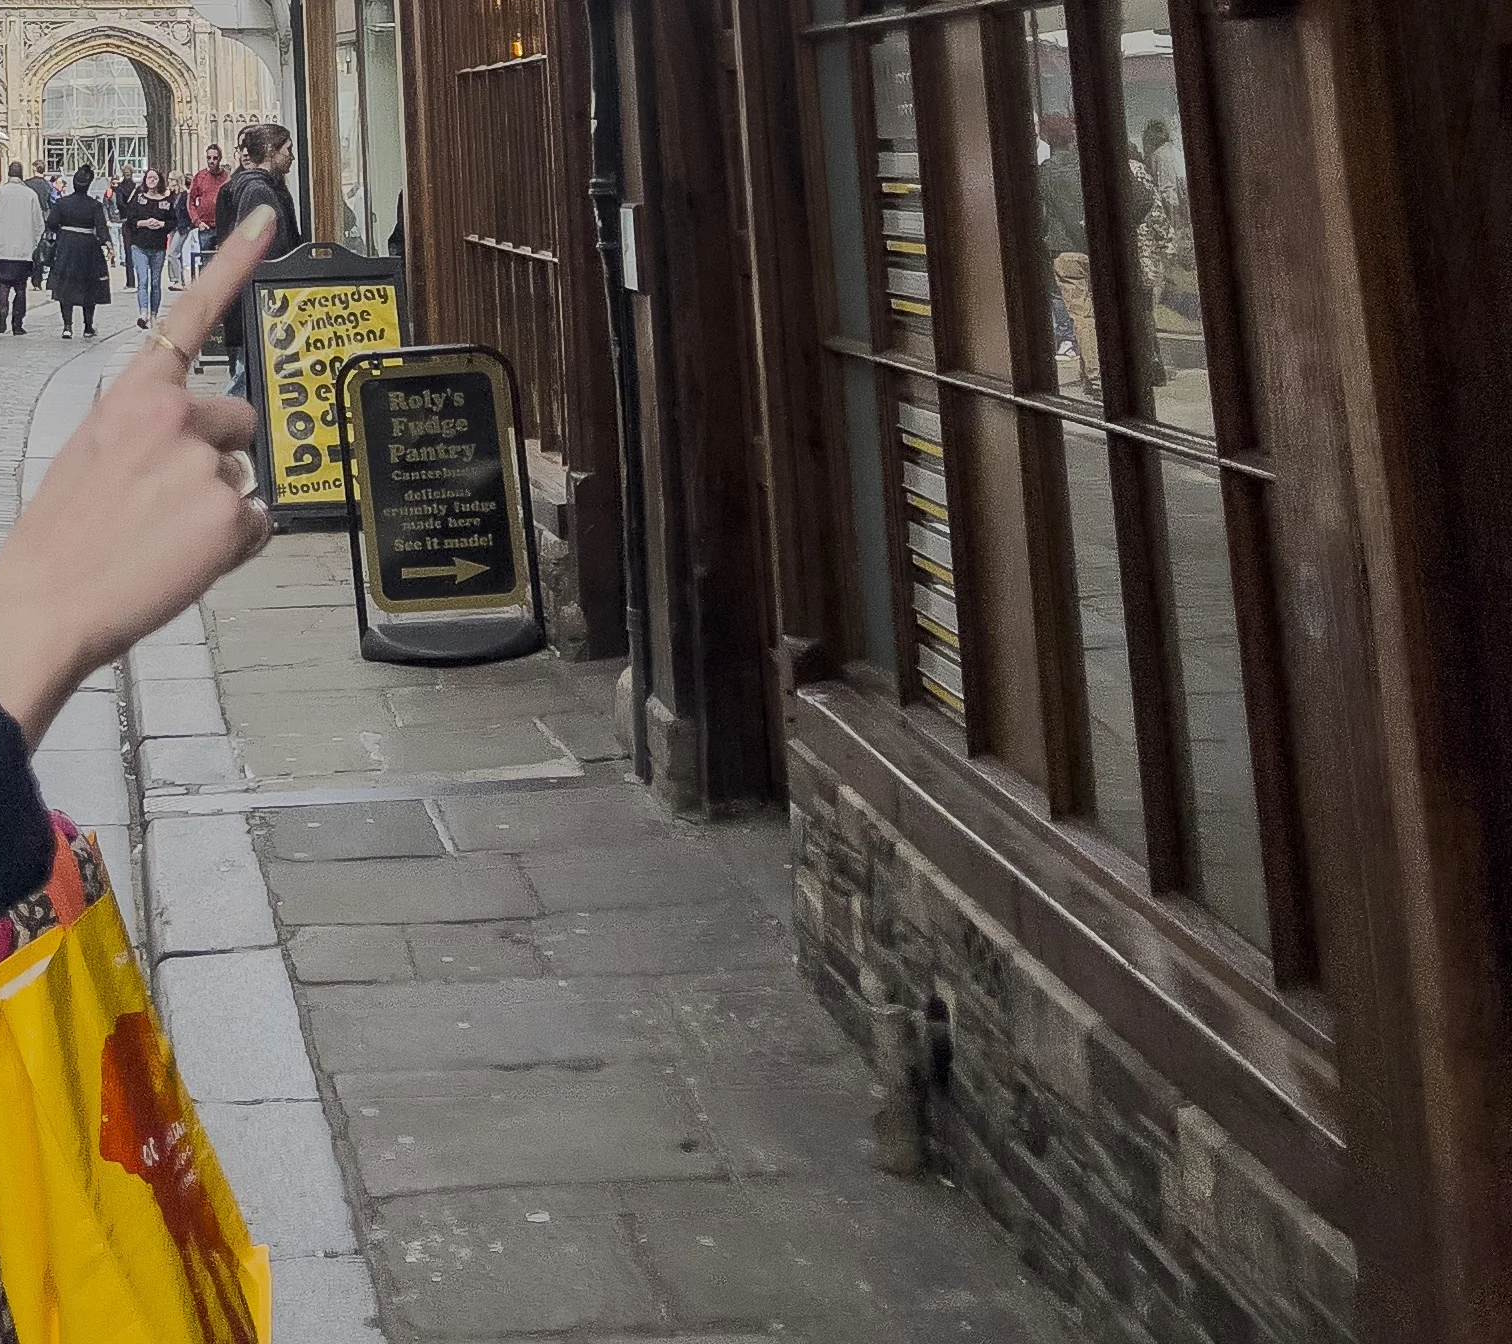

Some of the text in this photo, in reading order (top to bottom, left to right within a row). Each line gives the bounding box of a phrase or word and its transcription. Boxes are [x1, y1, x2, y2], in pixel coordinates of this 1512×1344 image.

[297, 285, 390, 312] everyday
[298, 308, 372, 331] vintage
[304, 326, 387, 353] fashions
[261, 286, 323, 478] bounce
[388, 388, 466, 413] Roly's
[390, 415, 470, 439] Fudge
[387, 441, 477, 464] Pantry
[403, 488, 472, 502] delicious
[382, 500, 498, 517] crumbly fudge
[401, 516, 482, 531] made here
[393, 532, 494, 552] See it made!
